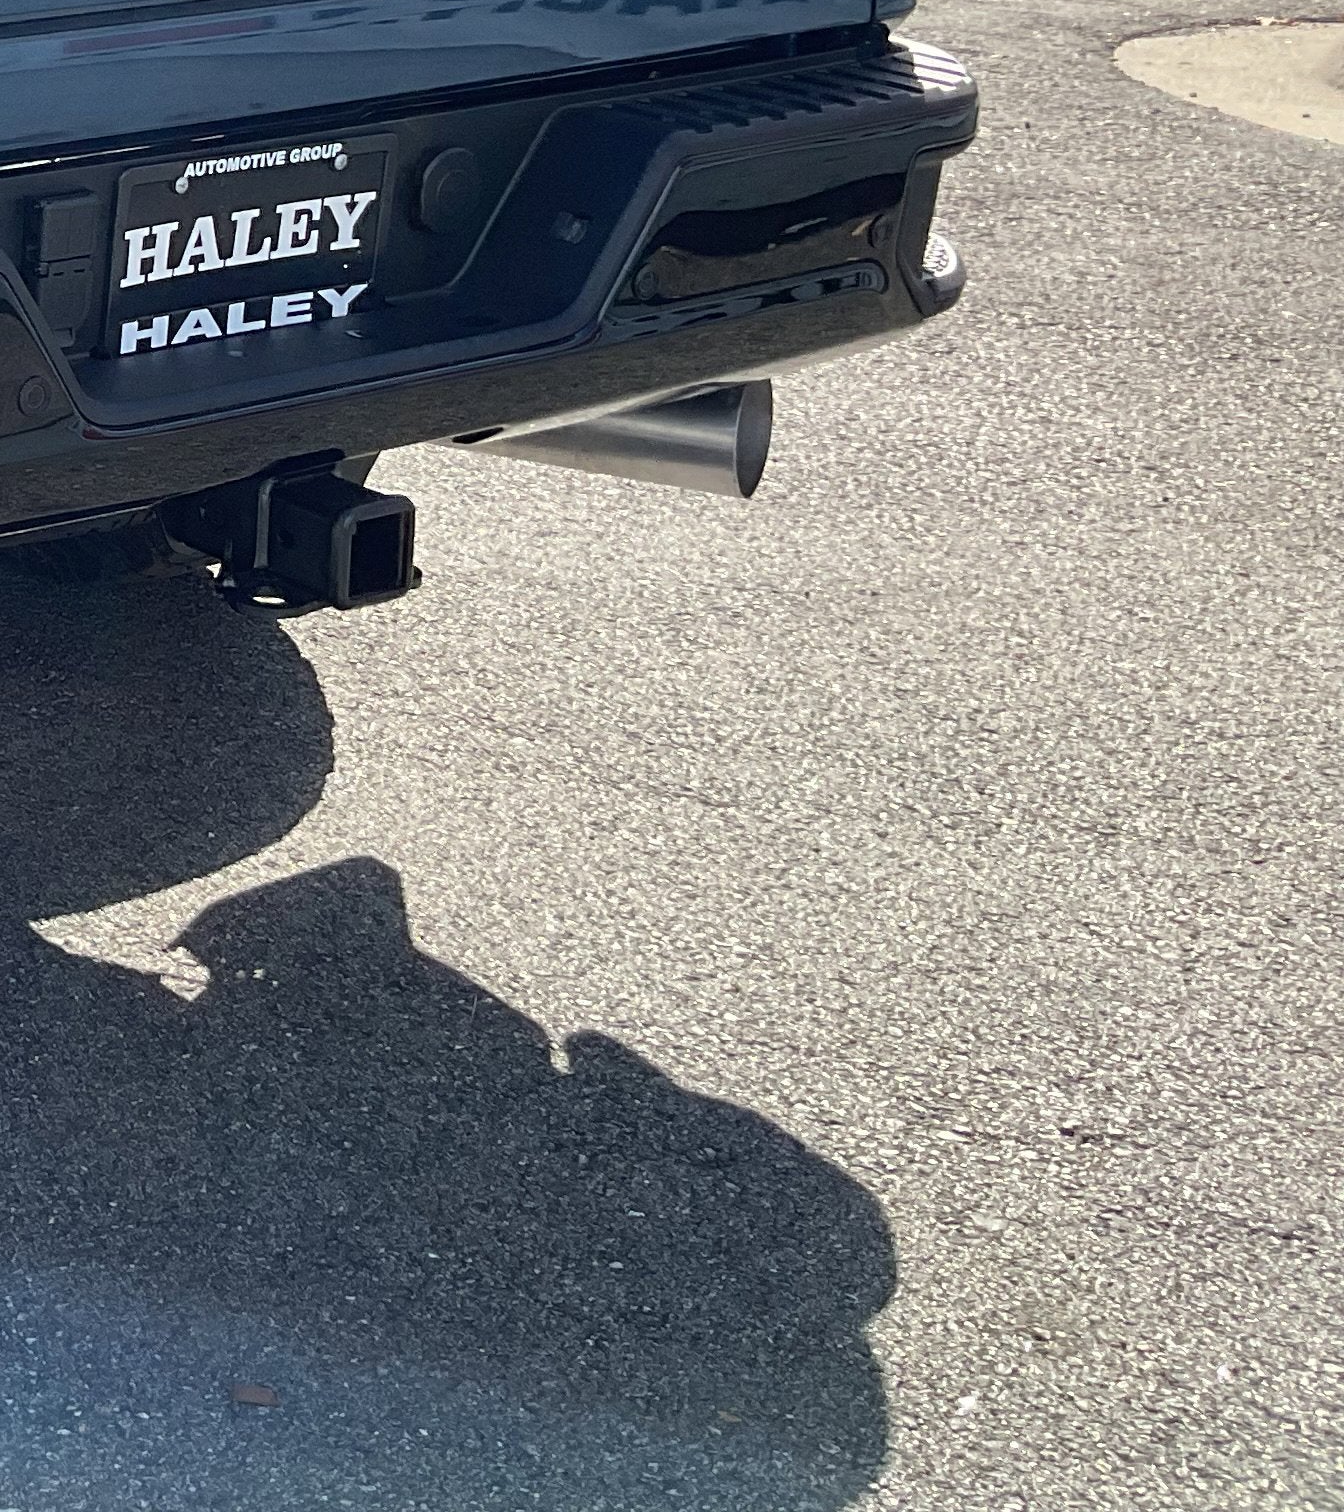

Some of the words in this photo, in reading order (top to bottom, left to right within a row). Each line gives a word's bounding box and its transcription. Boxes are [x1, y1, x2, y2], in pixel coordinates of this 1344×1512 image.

[184, 149, 286, 179] AUTOMOTIVE
[288, 142, 344, 166] GROUP
[119, 191, 378, 289] HALEY
[119, 282, 370, 356] HALEY
